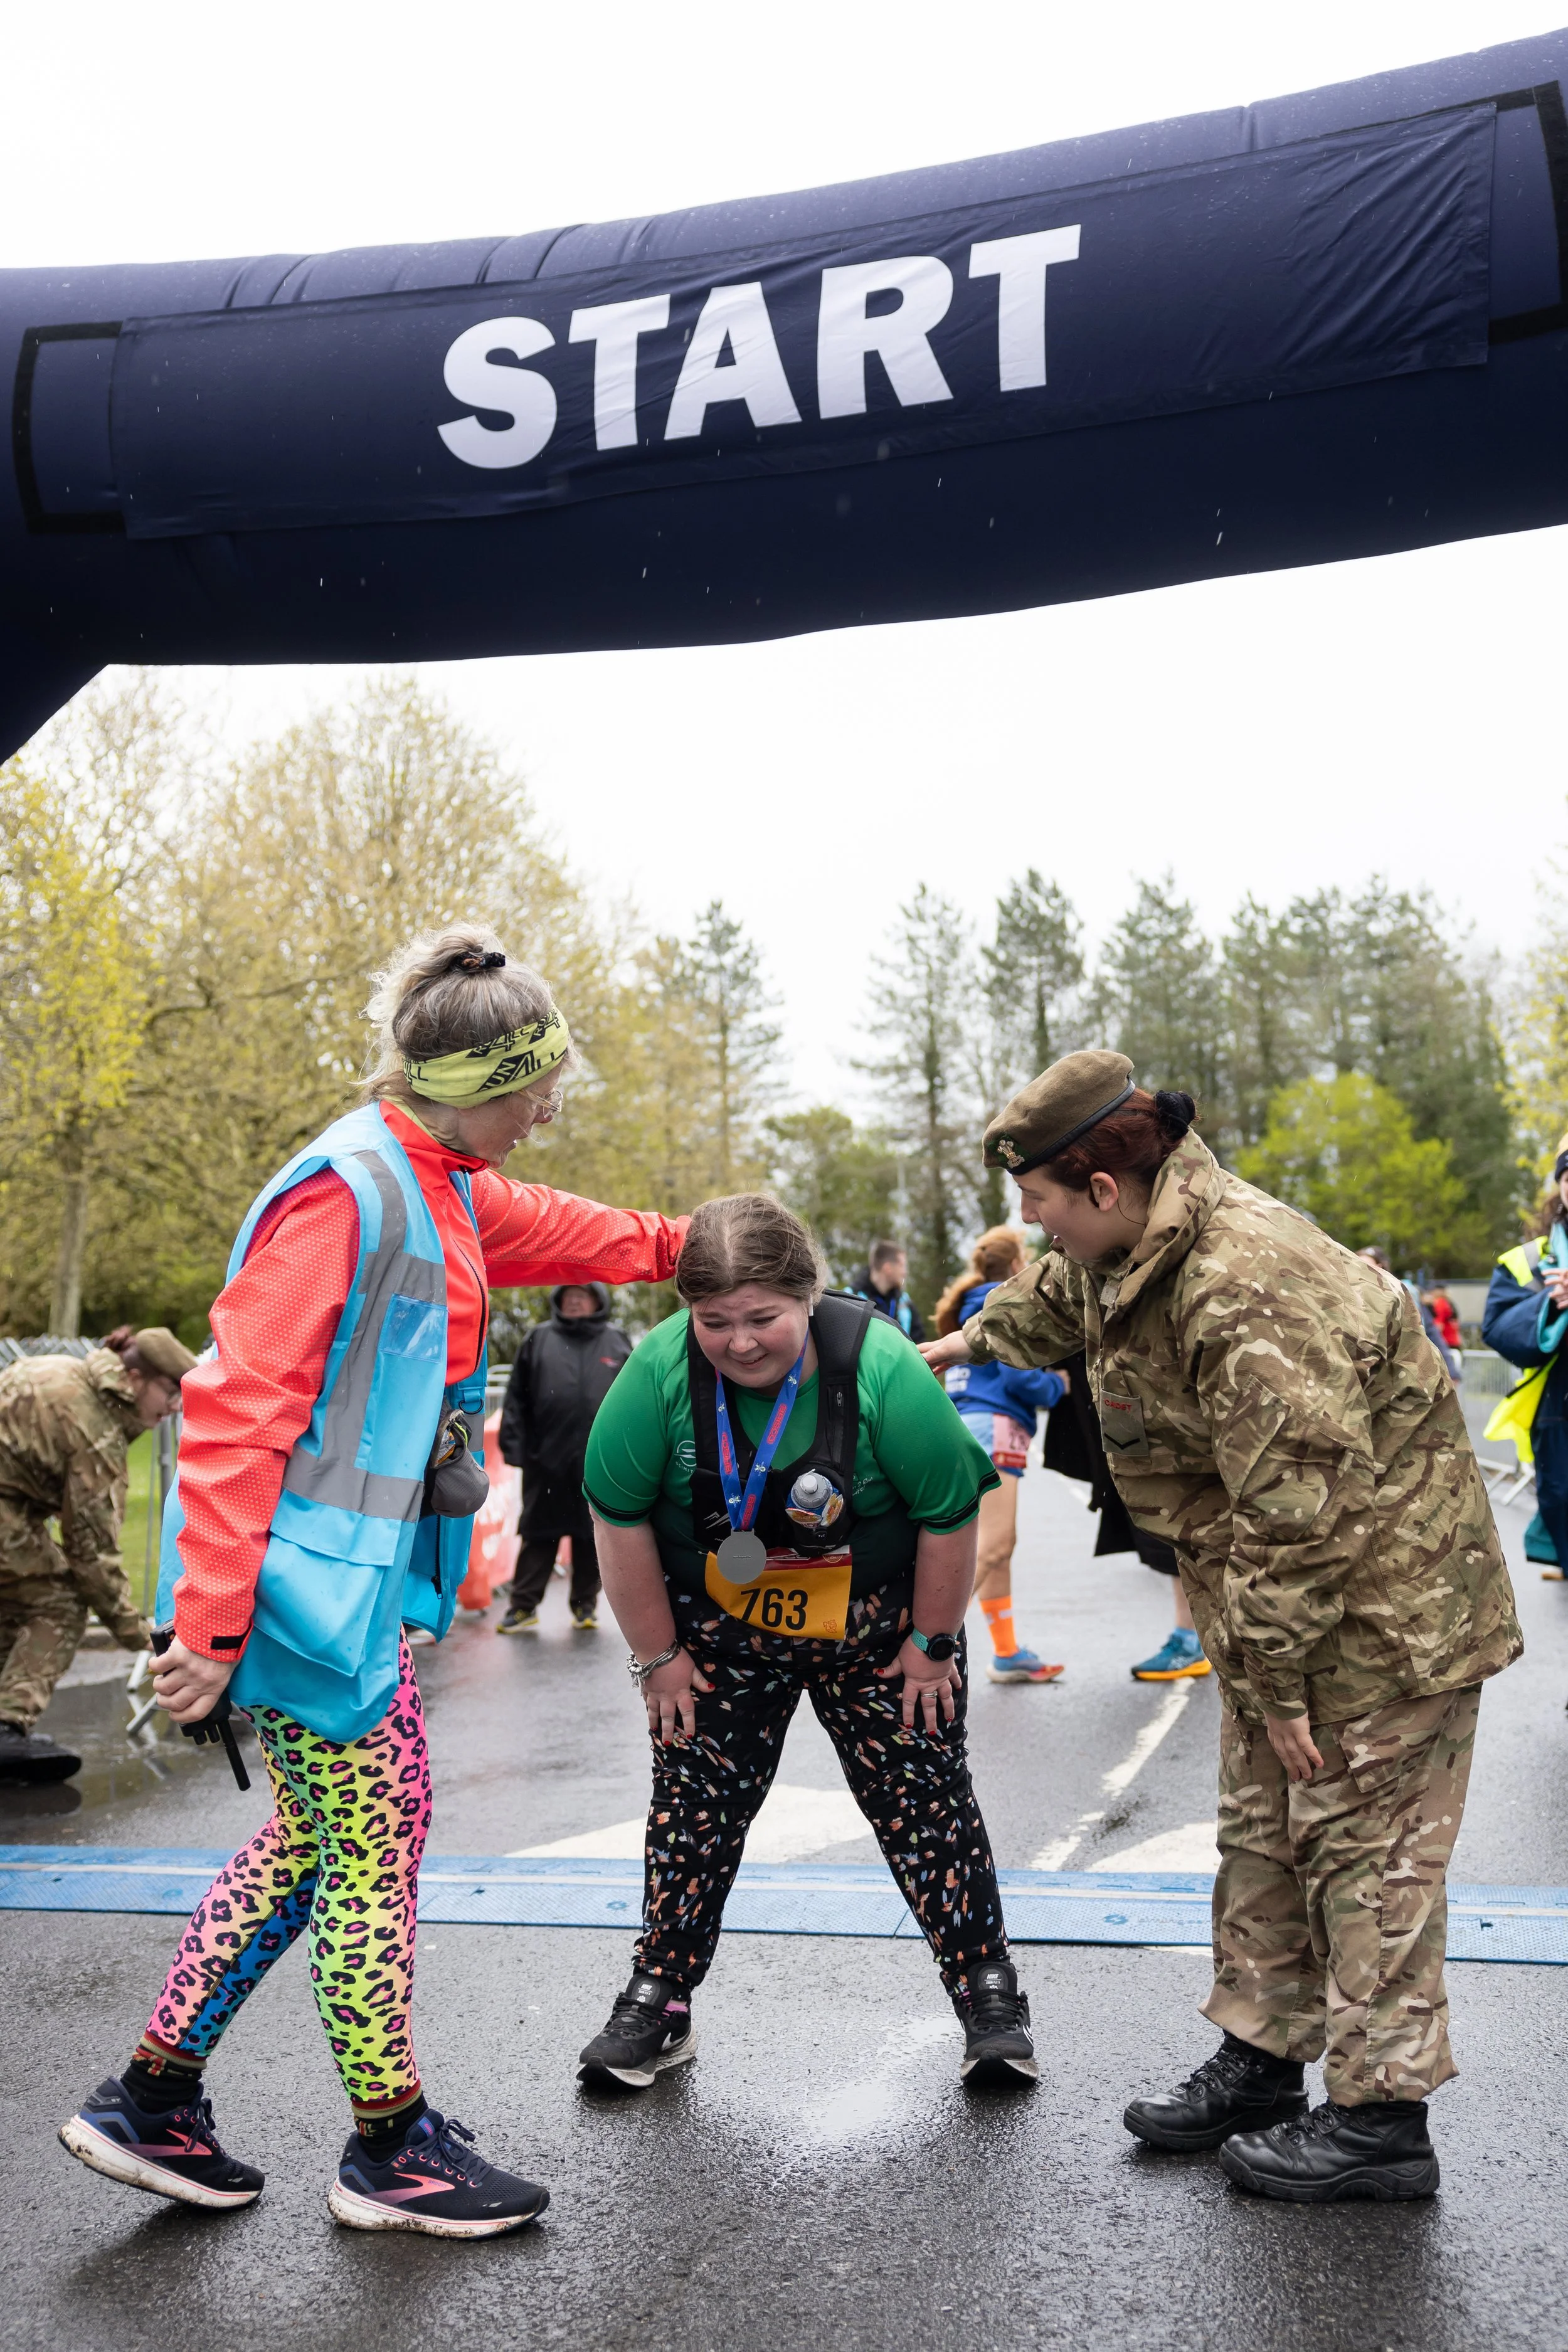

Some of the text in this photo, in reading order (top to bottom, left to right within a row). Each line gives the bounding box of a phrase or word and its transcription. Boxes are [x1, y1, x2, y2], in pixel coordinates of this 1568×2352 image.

[437, 224, 1081, 469] START
[1104, 1399, 1131, 1414] CADET
[675, 1461, 694, 1474] SCIMIT
[741, 1587, 808, 1631] 763
